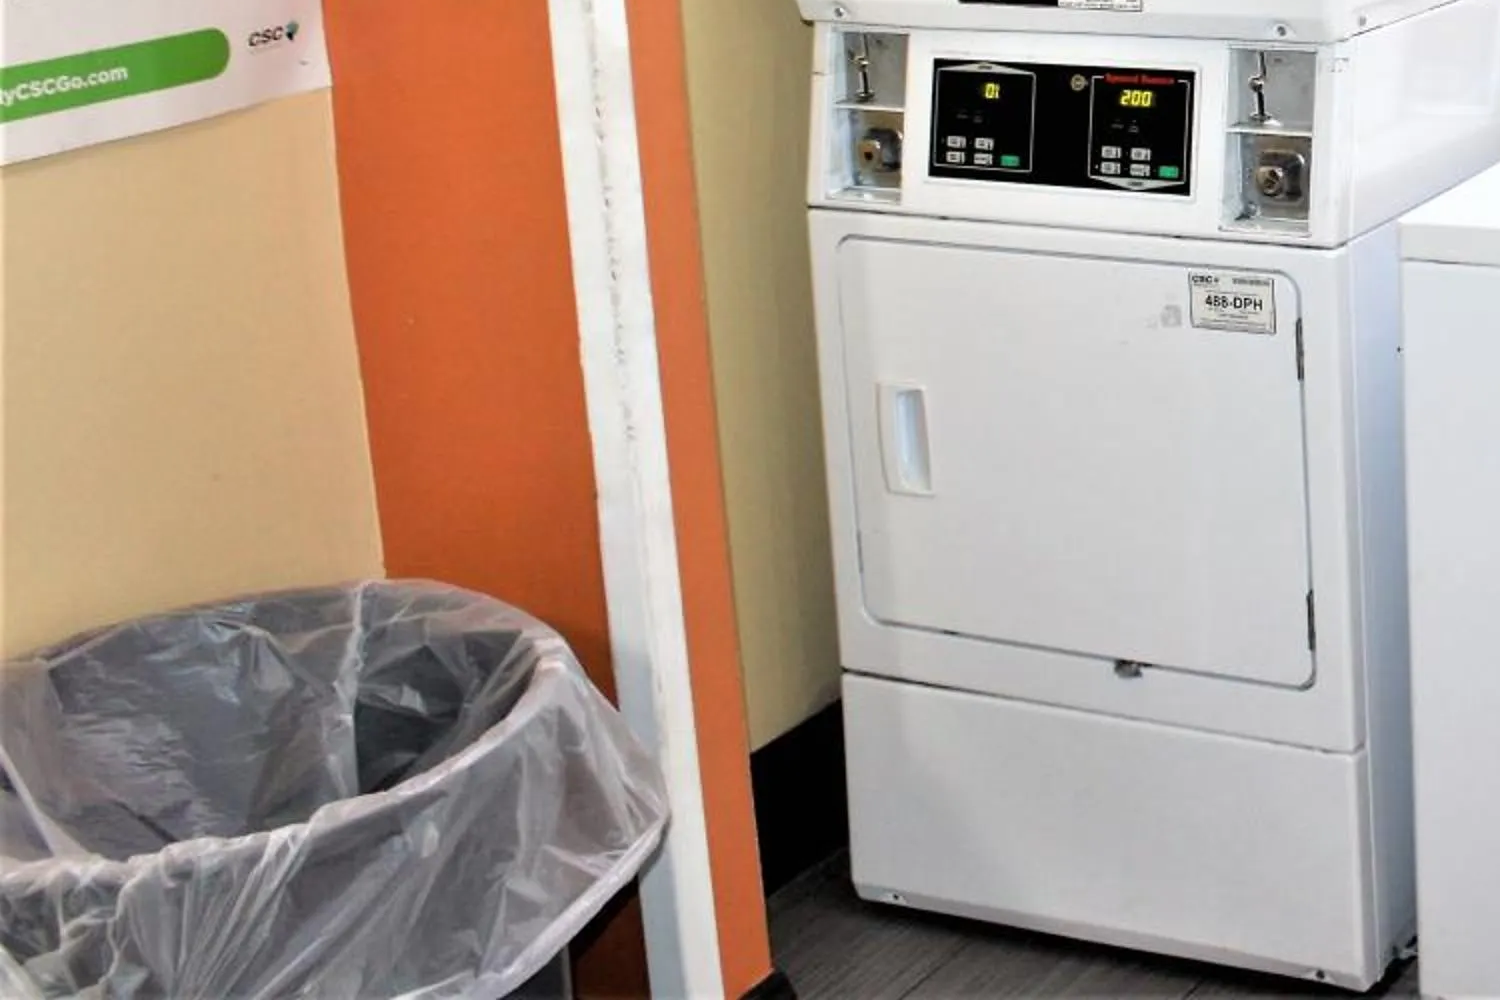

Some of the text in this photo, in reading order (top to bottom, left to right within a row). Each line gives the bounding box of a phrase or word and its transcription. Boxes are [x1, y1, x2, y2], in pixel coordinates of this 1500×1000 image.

[248, 25, 285, 47] CSC
[0, 66, 129, 107] yCSCGo.com
[1121, 90, 1152, 107] 200
